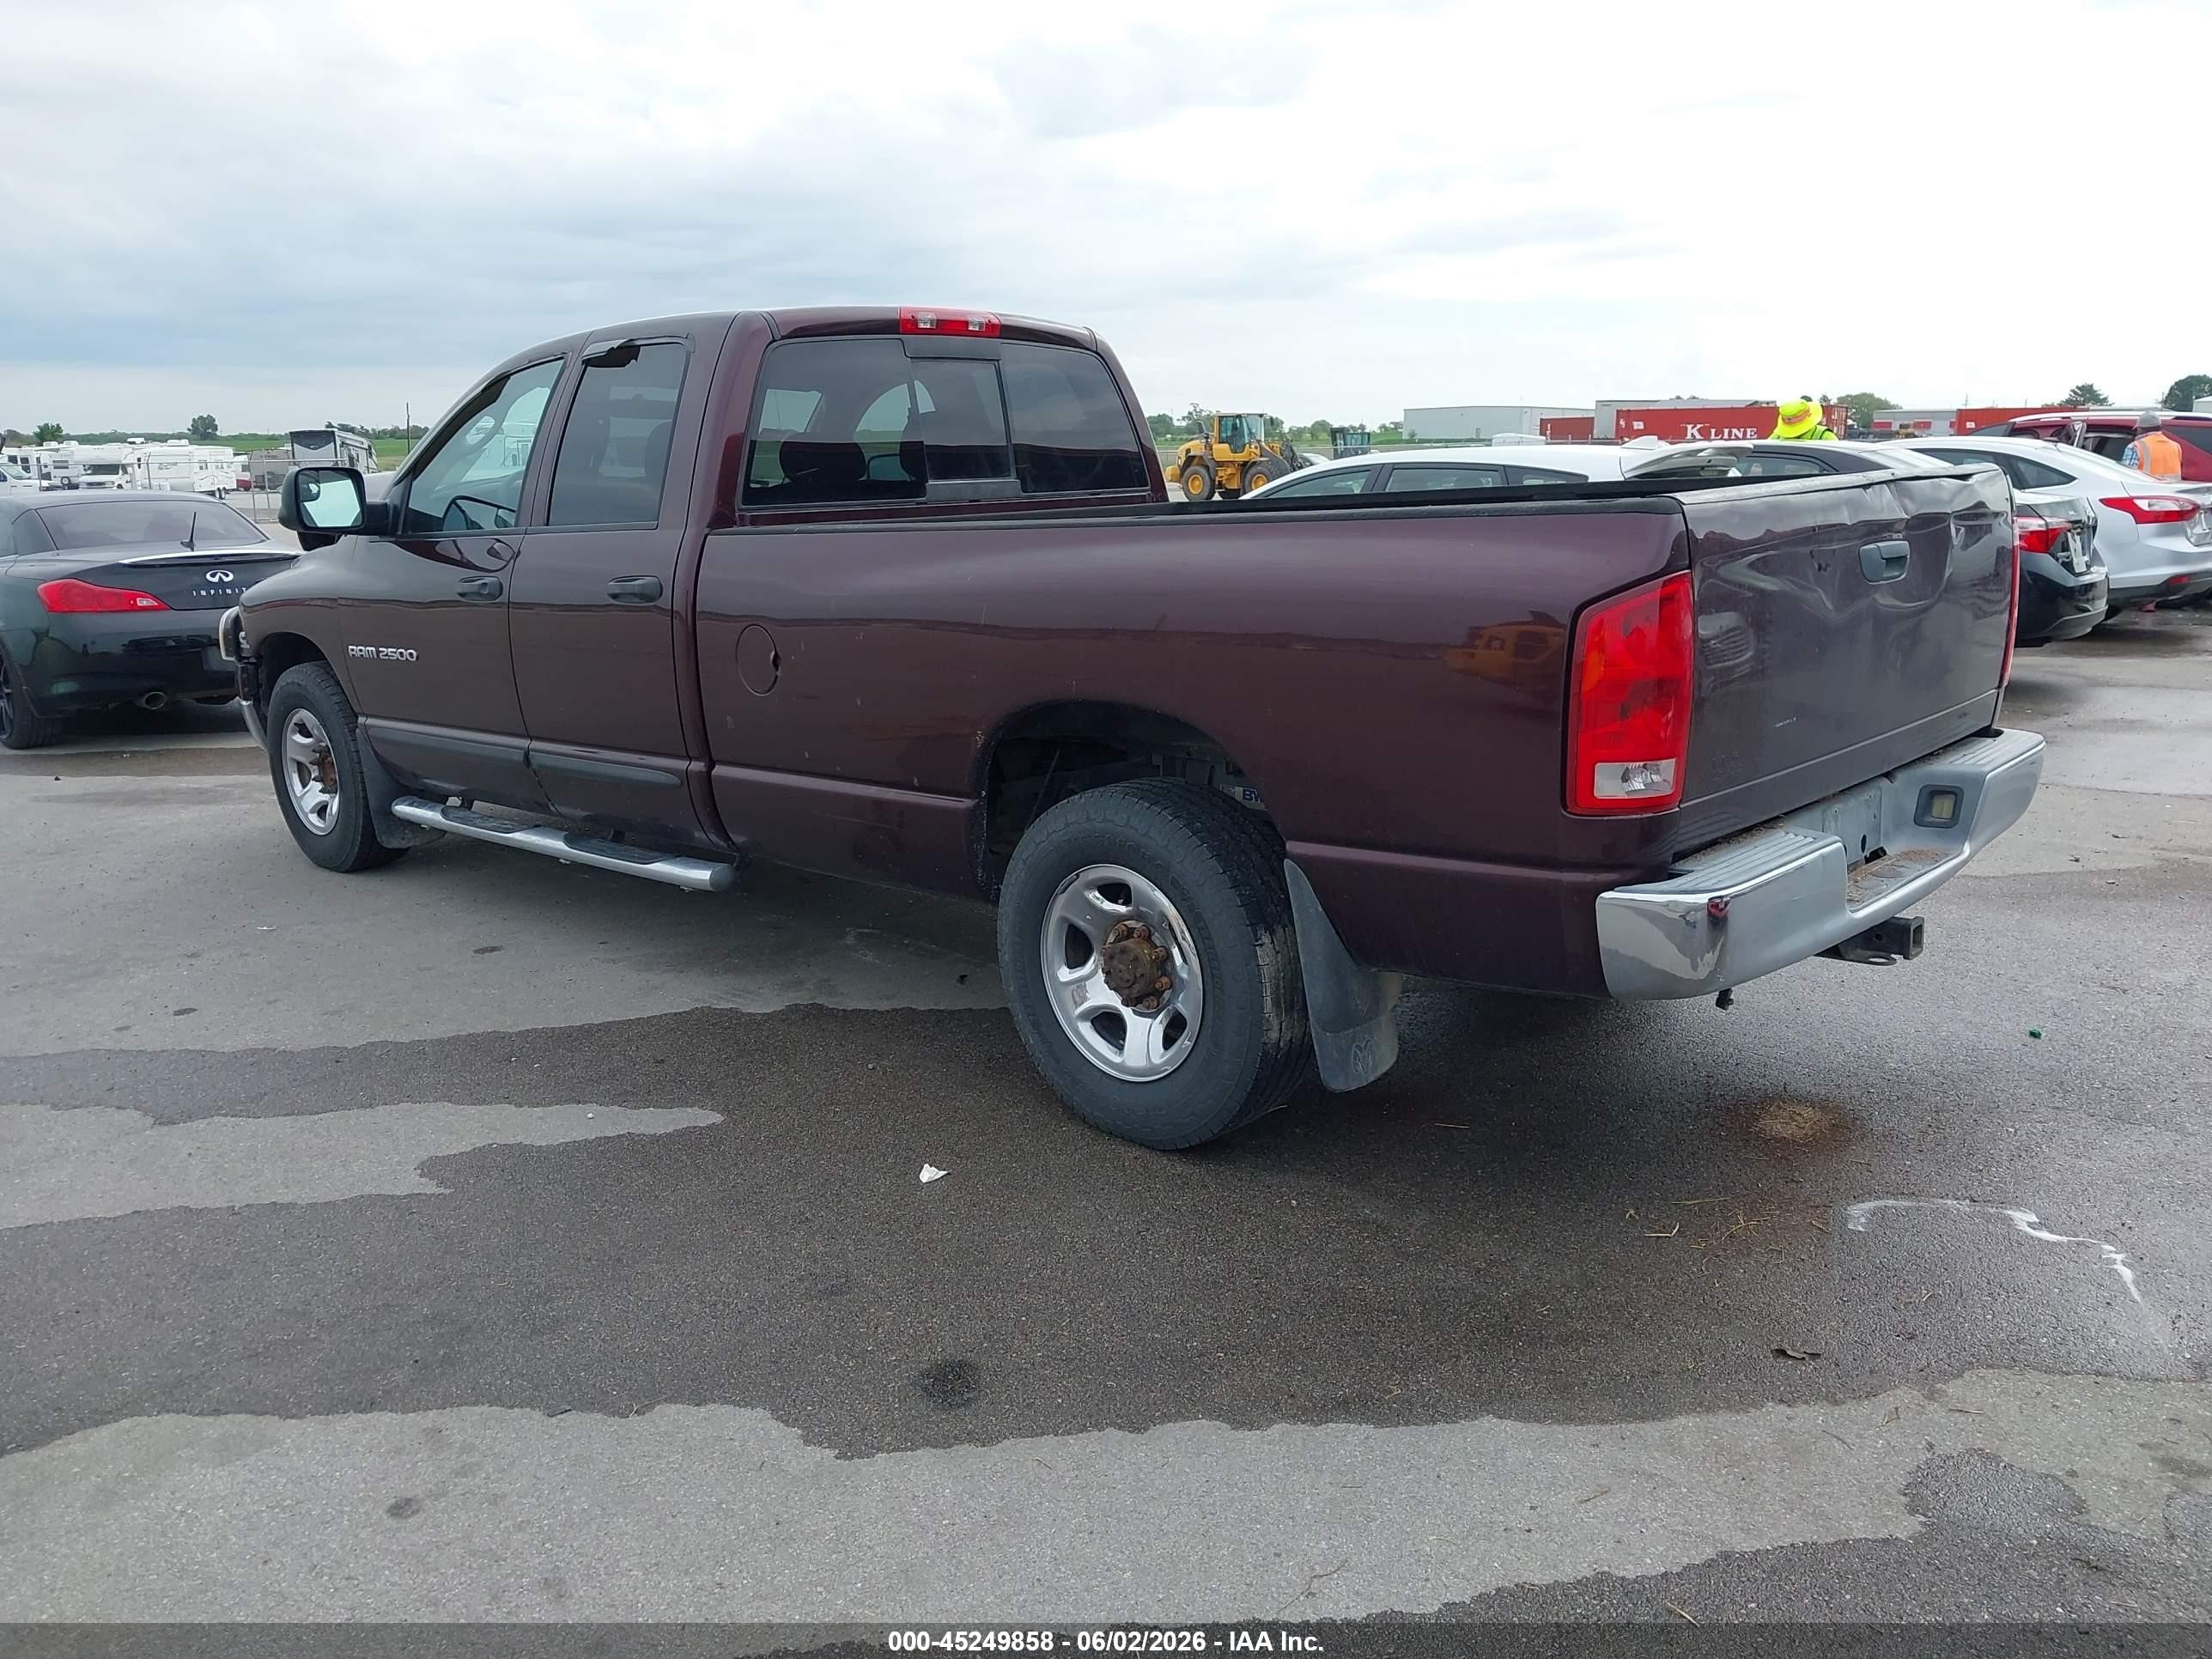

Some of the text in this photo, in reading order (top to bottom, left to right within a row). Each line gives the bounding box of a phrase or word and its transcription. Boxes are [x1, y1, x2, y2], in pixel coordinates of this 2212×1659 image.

[1710, 428, 1758, 440] LINE
[192, 586, 246, 597] INFINIT
[348, 645, 417, 661] RAM 2500
